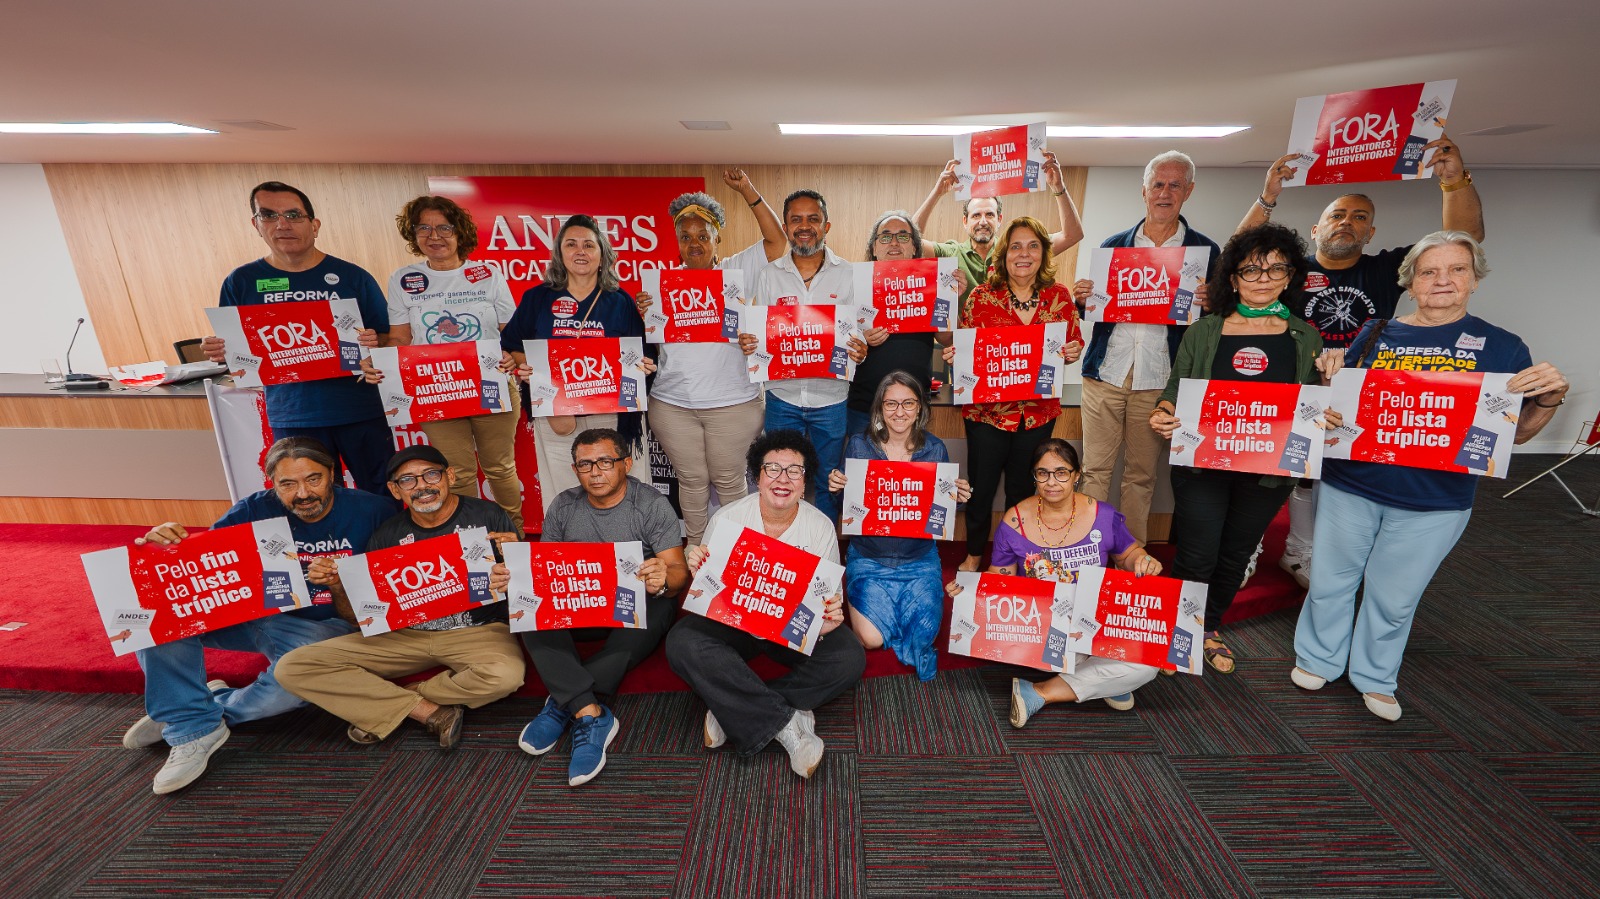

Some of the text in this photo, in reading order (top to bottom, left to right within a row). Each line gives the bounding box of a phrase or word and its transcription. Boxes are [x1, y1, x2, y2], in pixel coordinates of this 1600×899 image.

[1330, 108, 1399, 148] FORA
[982, 142, 1016, 156] EM LUTA
[1327, 140, 1391, 157] INTERVENTORES
[992, 154, 1006, 162] PELA
[1326, 148, 1397, 166] INTERVENTORAS!
[978, 159, 1022, 174] AUTONOMIA
[978, 169, 1022, 182] UNIVERSITÁRIA
[487, 215, 658, 252] ANES
[884, 277, 904, 291] Pelo
[907, 275, 926, 289] fim
[1117, 264, 1170, 292] FORA
[264, 291, 340, 303] REFORMA
[669, 286, 718, 313] FORA
[885, 291, 924, 305] da lista
[1117, 290, 1166, 299] INTERVENTORES
[1117, 297, 1170, 307] INTERVENTORAS!
[1339, 286, 1376, 314] SINDICATO
[674, 310, 715, 319] INTERVENTORES
[886, 306, 927, 320] tríplice
[553, 319, 604, 329] REFORMA
[778, 323, 800, 337] Pelo
[803, 322, 823, 335] fim
[257, 319, 330, 352] FORA
[268, 344, 327, 360] INTERVENTORES
[780, 338, 820, 352] da lista
[986, 343, 1008, 358] Pelo
[1010, 342, 1031, 355] fim
[236, 355, 258, 364] ANDES
[272, 350, 336, 368] INTERVENTORAS!
[781, 352, 825, 366] tríplice
[1396, 347, 1452, 356] DEFESA
[1456, 350, 1476, 360] DA
[416, 360, 464, 377] EM LUTA
[559, 354, 614, 382] FORA
[986, 358, 1028, 373] da lista
[432, 373, 453, 383] PELA
[564, 379, 611, 391] INTERVENTORES
[987, 372, 1031, 388] tríplice
[416, 379, 476, 395] AUTONOMIA
[417, 389, 478, 405] UNIVERSITÁRIA
[1379, 391, 1455, 409] Pelo fim
[1218, 400, 1278, 416] Pelo fim
[1216, 418, 1271, 434] da lista
[1378, 409, 1447, 428] da lista
[1182, 431, 1200, 442] ANDES
[1376, 428, 1450, 448] tríplice
[1215, 436, 1274, 454] tríplice
[878, 478, 922, 491] Pelo fim
[878, 493, 918, 506] da lista
[877, 507, 922, 523] tríplice
[294, 538, 352, 553] FORMA
[1052, 544, 1097, 559] EU DEFENDO
[155, 550, 239, 582] Pelo fim
[546, 560, 602, 576] Pelo fim
[743, 552, 796, 584] Pelo fim
[385, 554, 458, 596] FORA
[705, 574, 720, 591] ANDES
[164, 570, 241, 601] da lista
[396, 578, 456, 603] INTERVENTORES
[550, 577, 601, 593] da lista
[738, 571, 787, 600] da lista
[172, 584, 252, 618] tríplice
[400, 583, 465, 611] INTERVENTORAS!
[552, 593, 607, 612] tríplice
[732, 588, 784, 619] tríplice
[1115, 592, 1162, 610] EM LUTA
[986, 595, 1041, 628] FORA
[1127, 606, 1147, 617] PELA
[986, 624, 1037, 633] INTERVENTORES
[1081, 617, 1097, 630] ANDES
[1105, 614, 1167, 633] AUTONOMIA
[986, 632, 1042, 643] INTERVENTORAS!
[1104, 626, 1168, 645] UNIVERSITÁRIA
